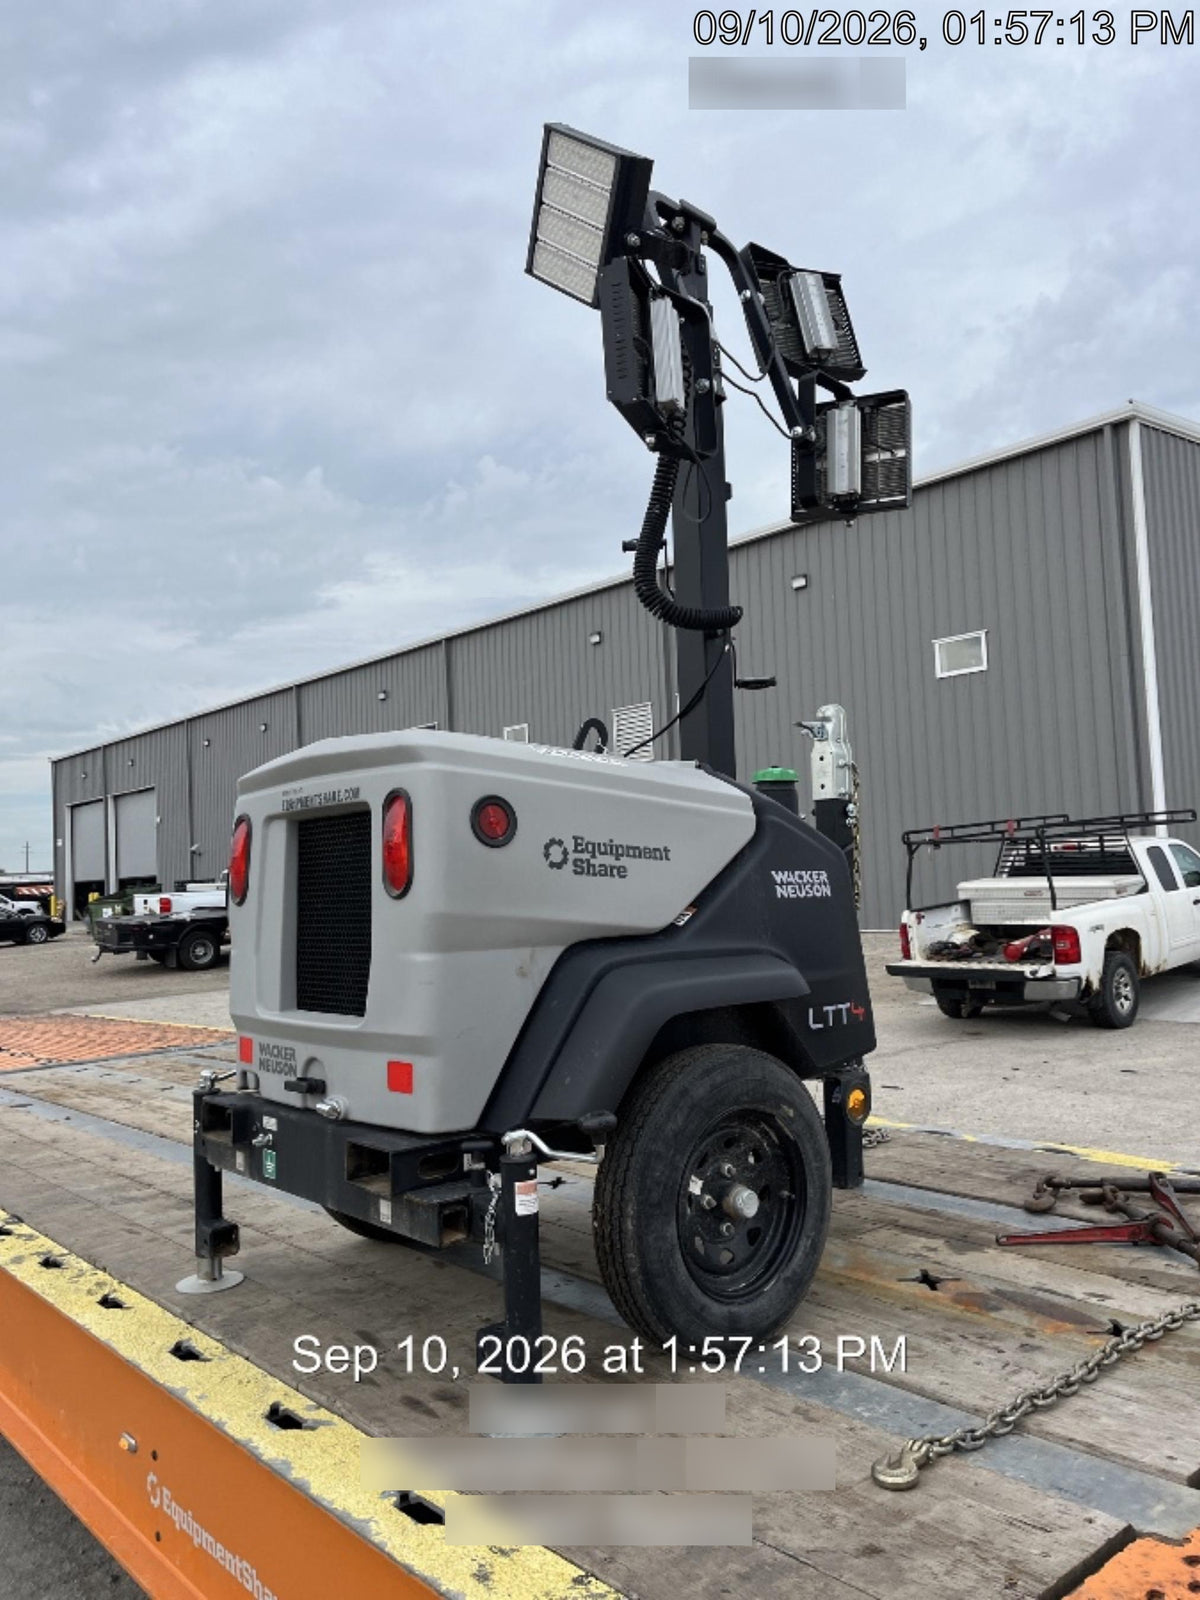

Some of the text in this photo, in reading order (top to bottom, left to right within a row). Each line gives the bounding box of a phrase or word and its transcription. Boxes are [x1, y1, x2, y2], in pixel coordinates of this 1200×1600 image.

[572, 835, 671, 861] Equipment
[572, 858, 628, 879] Share
[770, 870, 829, 885] WACKER
[775, 884, 832, 899] NEUSON
[808, 1000, 865, 1030] LTT4
[258, 1041, 296, 1061] WACKER
[258, 1057, 298, 1078] NEUSON
